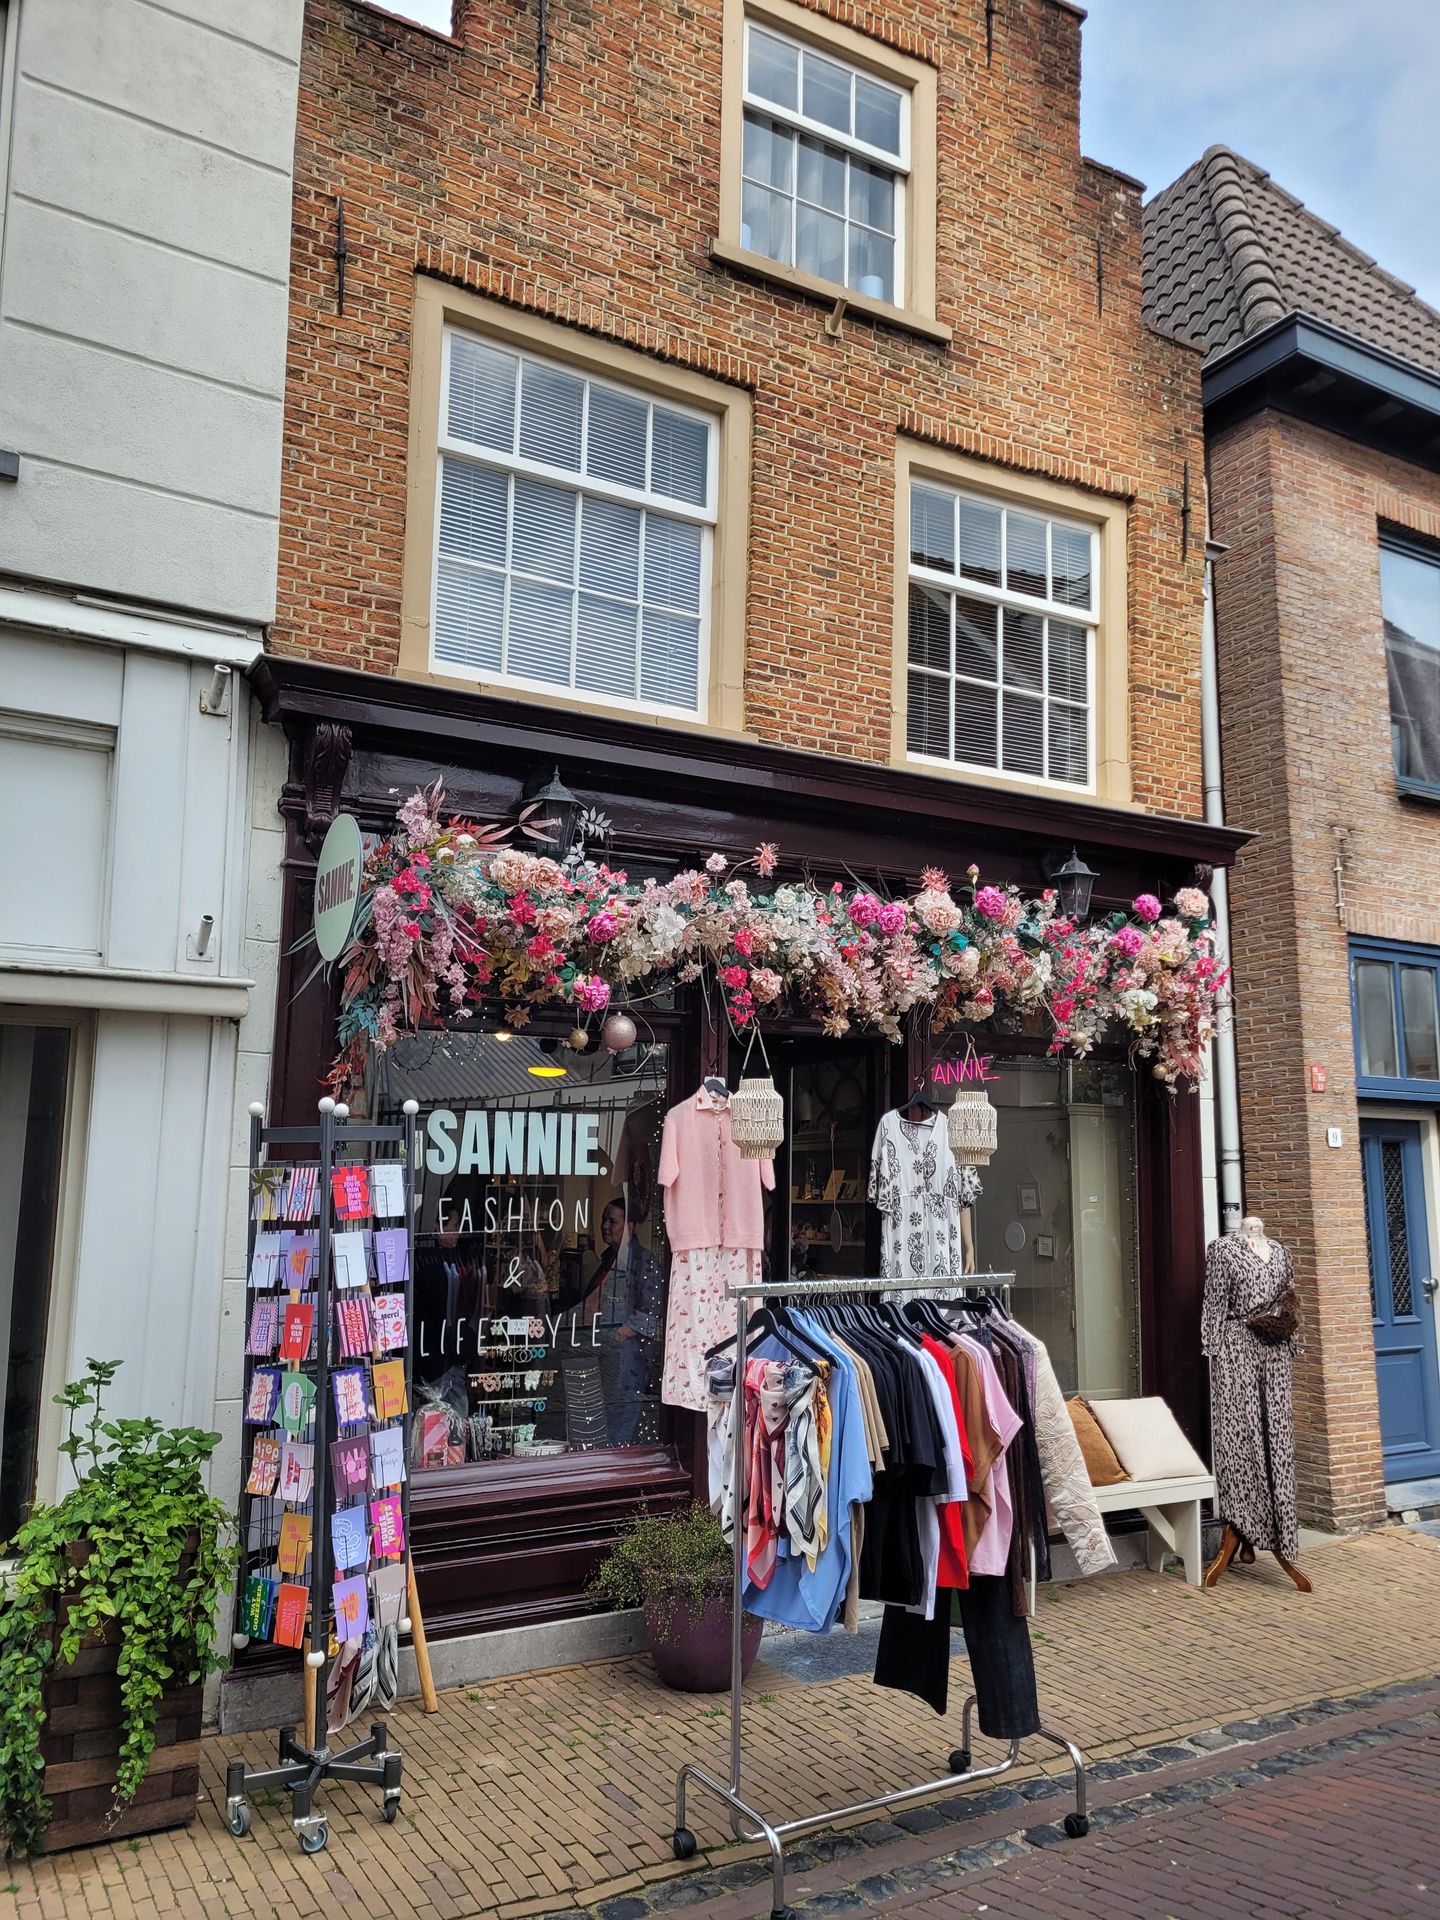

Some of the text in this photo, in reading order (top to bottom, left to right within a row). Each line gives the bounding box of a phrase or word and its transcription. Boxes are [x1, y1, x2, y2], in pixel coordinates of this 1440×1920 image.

[318, 858, 355, 914] SANNIE.
[426, 1109, 608, 1176] SANNIE.
[438, 1197, 590, 1233] FASHION
[503, 1256, 525, 1288] &
[380, 1311, 400, 1321] Merci
[420, 1312, 603, 1357] LIFESTYLE
[253, 1440, 279, 1461] Hiep
[379, 1515, 388, 1547] DOUZE
[385, 1505, 396, 1543] POINTS
